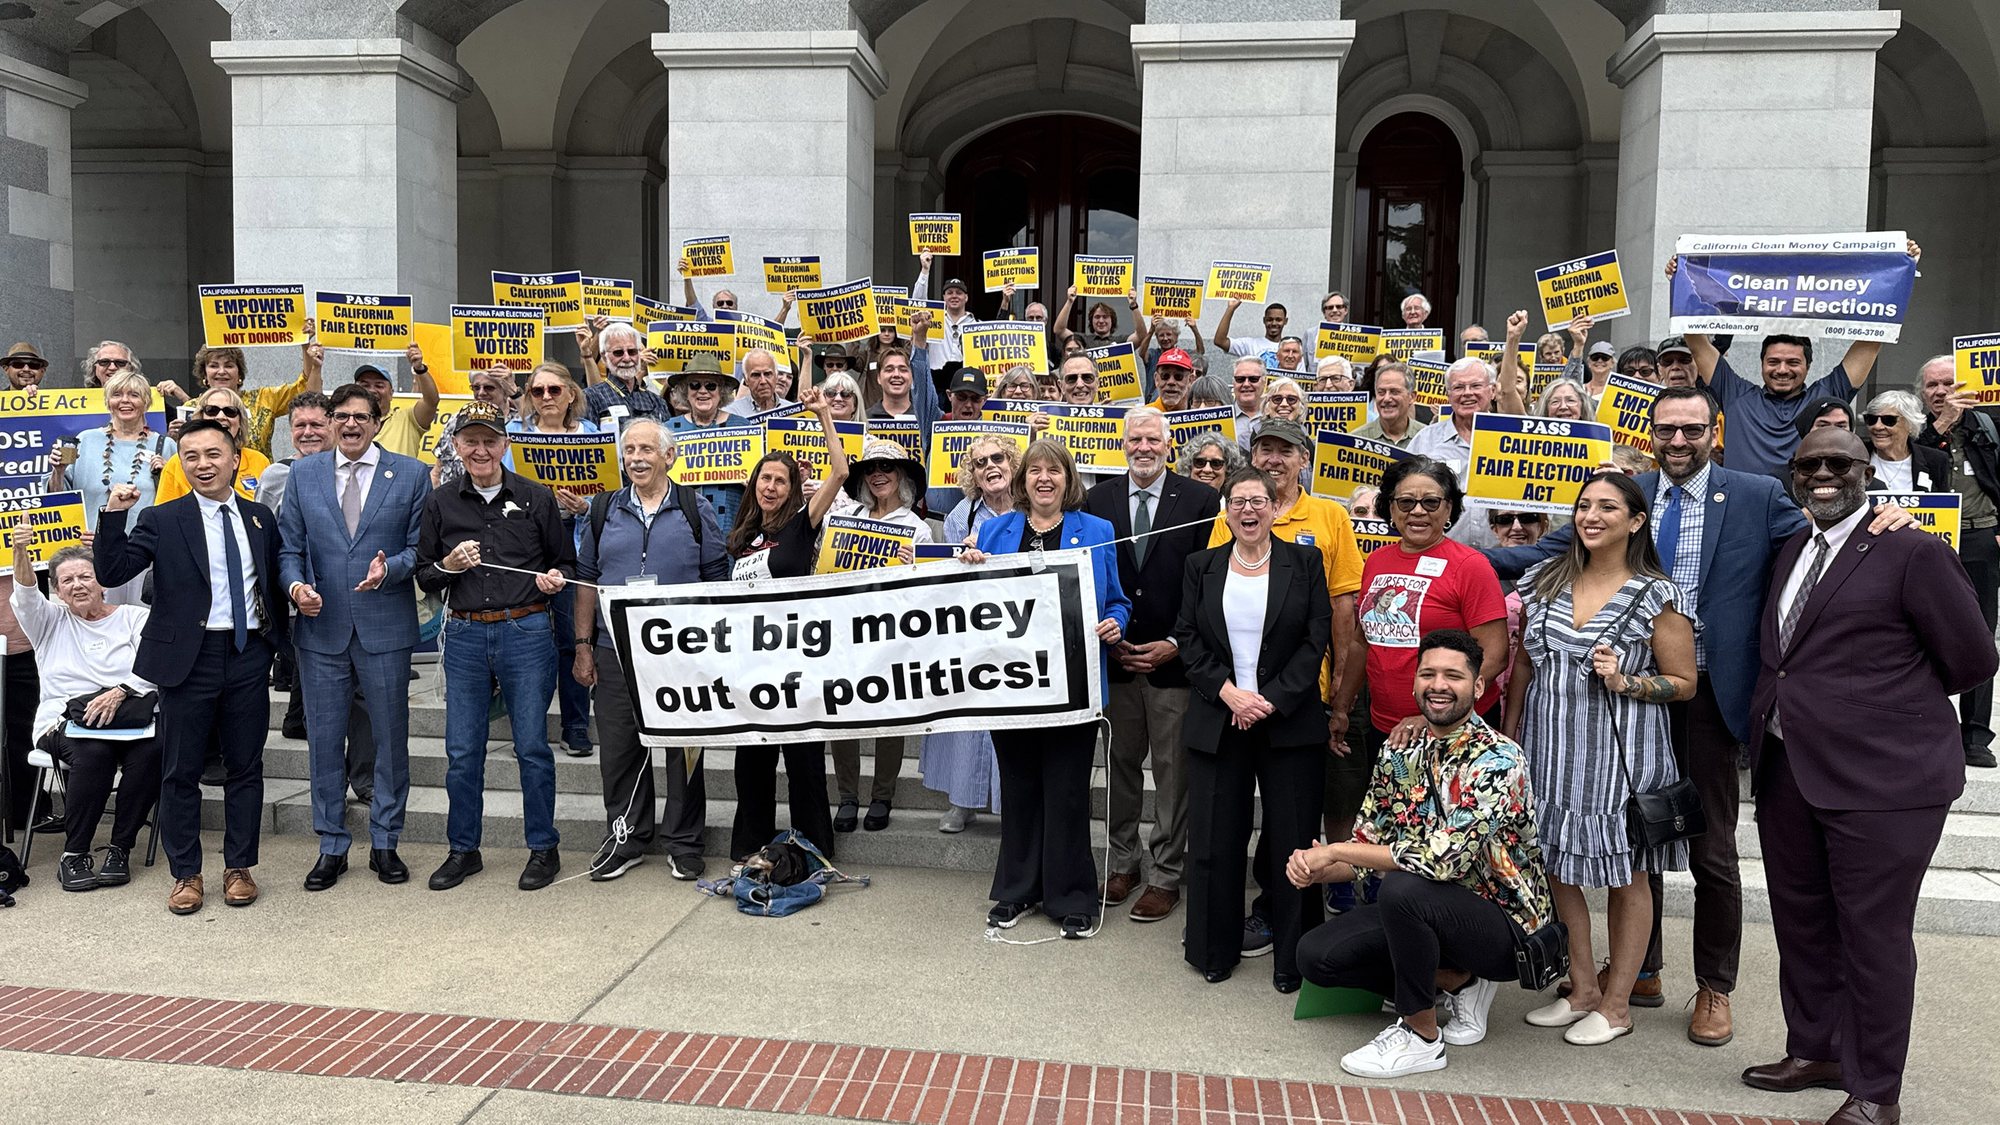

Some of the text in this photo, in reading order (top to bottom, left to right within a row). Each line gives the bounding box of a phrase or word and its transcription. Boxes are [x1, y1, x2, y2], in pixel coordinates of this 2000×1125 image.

[915, 224, 953, 233] EMPOWER
[918, 234, 948, 243] VOTERS
[686, 245, 725, 257] EMPOWER
[1693, 242, 1747, 250] California
[1789, 241, 1828, 250] Money
[1833, 241, 1895, 250] Campaign
[692, 256, 722, 266] VOTERS
[993, 258, 1026, 266] CALIFORNIA
[703, 267, 726, 275] DONORS
[774, 265, 810, 273] CALIFORNIA
[987, 267, 1035, 278] FAIR ELECTIONS
[1082, 265, 1126, 275] EMPOWER
[1559, 261, 1587, 275] PASS
[521, 277, 553, 285] PASS
[768, 275, 819, 283] FAIR ELECTIONS
[1087, 275, 1120, 285] VOTERS
[1217, 270, 1262, 281] EMPOWER
[1552, 270, 1602, 292] CALIFORNIA
[839, 284, 862, 294] ELECTIONS
[1096, 287, 1122, 295] DONORS
[1220, 279, 1255, 291] VOTERS
[1728, 275, 1871, 295] Clean Money
[203, 288, 239, 296] CALIFORNIA
[510, 287, 566, 298] CALIFORNIA
[584, 287, 622, 297] CALIFORNIA
[1150, 286, 1196, 297] EMPOWER
[1215, 290, 1256, 301] NOT DONORS
[1545, 282, 1619, 310] FAIR ELECTIONS
[346, 295, 380, 305] PASS
[594, 298, 630, 308] ELECTIONS
[807, 293, 867, 317] EMPOWER
[1155, 297, 1189, 308] VOTERS
[215, 299, 294, 314] EMPOWER
[597, 308, 610, 316] ACT
[654, 303, 676, 312] PASS
[1572, 305, 1590, 318] ACT
[1744, 296, 1898, 317] Fair Elections
[333, 306, 394, 320] CALIFORNIA
[816, 309, 864, 329] VOTERS
[1165, 309, 1192, 318] DONORS
[226, 314, 287, 329] VOTERS
[741, 314, 765, 326] PASS
[321, 320, 407, 335] FAIR ELECTIONS
[465, 322, 535, 338] EMPOWER
[676, 324, 707, 332] PASS
[815, 325, 870, 342] NOT DONORS
[963, 325, 992, 333] CALIFORNIA
[1688, 322, 1884, 337] www.CAclean.org (800) 566-3780
[224, 332, 294, 344] NOT DONORS
[354, 337, 375, 349] ACT
[664, 334, 719, 346] CALIFORNIA
[973, 334, 1035, 349] EMPOWER
[1330, 332, 1368, 343] CALIFORNIA
[1386, 339, 1433, 348] EMPOWER
[475, 339, 528, 355] VOTERS
[743, 337, 785, 354] ELECTIONS
[1320, 341, 1375, 354] FAIR ELECTIONS
[981, 346, 1030, 361] VOTERS
[470, 358, 492, 369] NOT
[1610, 377, 1647, 394] CALIFORNIA
[55, 395, 87, 409] Act
[1098, 392, 1110, 401] ACT
[1006, 402, 1038, 411] PASS
[1070, 408, 1104, 417] PASS
[1168, 416, 1182, 424] FAIR
[1183, 412, 1217, 422] ELECTIONS
[935, 425, 967, 433] CALIFORNIA
[983, 425, 1014, 433] ELECTIONS
[1056, 419, 1117, 433] CALIFORNIA
[1522, 420, 1571, 436] PASS
[676, 439, 751, 456] EMPOWER
[1354, 439, 1391, 456] PASS
[1499, 436, 1588, 459] CALIFORNIA
[523, 448, 606, 464] EMPOWER
[686, 453, 742, 468] VOTERS
[1075, 453, 1096, 464] ACT
[534, 464, 598, 481] VOTERS
[680, 469, 748, 482] NOT DONORS
[1320, 463, 1349, 480] FAIR
[1476, 456, 1595, 483] FAIR ELECTION
[1522, 483, 1555, 502] ACT
[829, 518, 914, 537] CALIFORNIA FAIR ELECTIONS ACT
[832, 532, 899, 556] EMPOWER
[1372, 576, 1427, 590] NURSES FOR
[640, 599, 1036, 658] Get big money
[655, 650, 1051, 715] out of politics!
